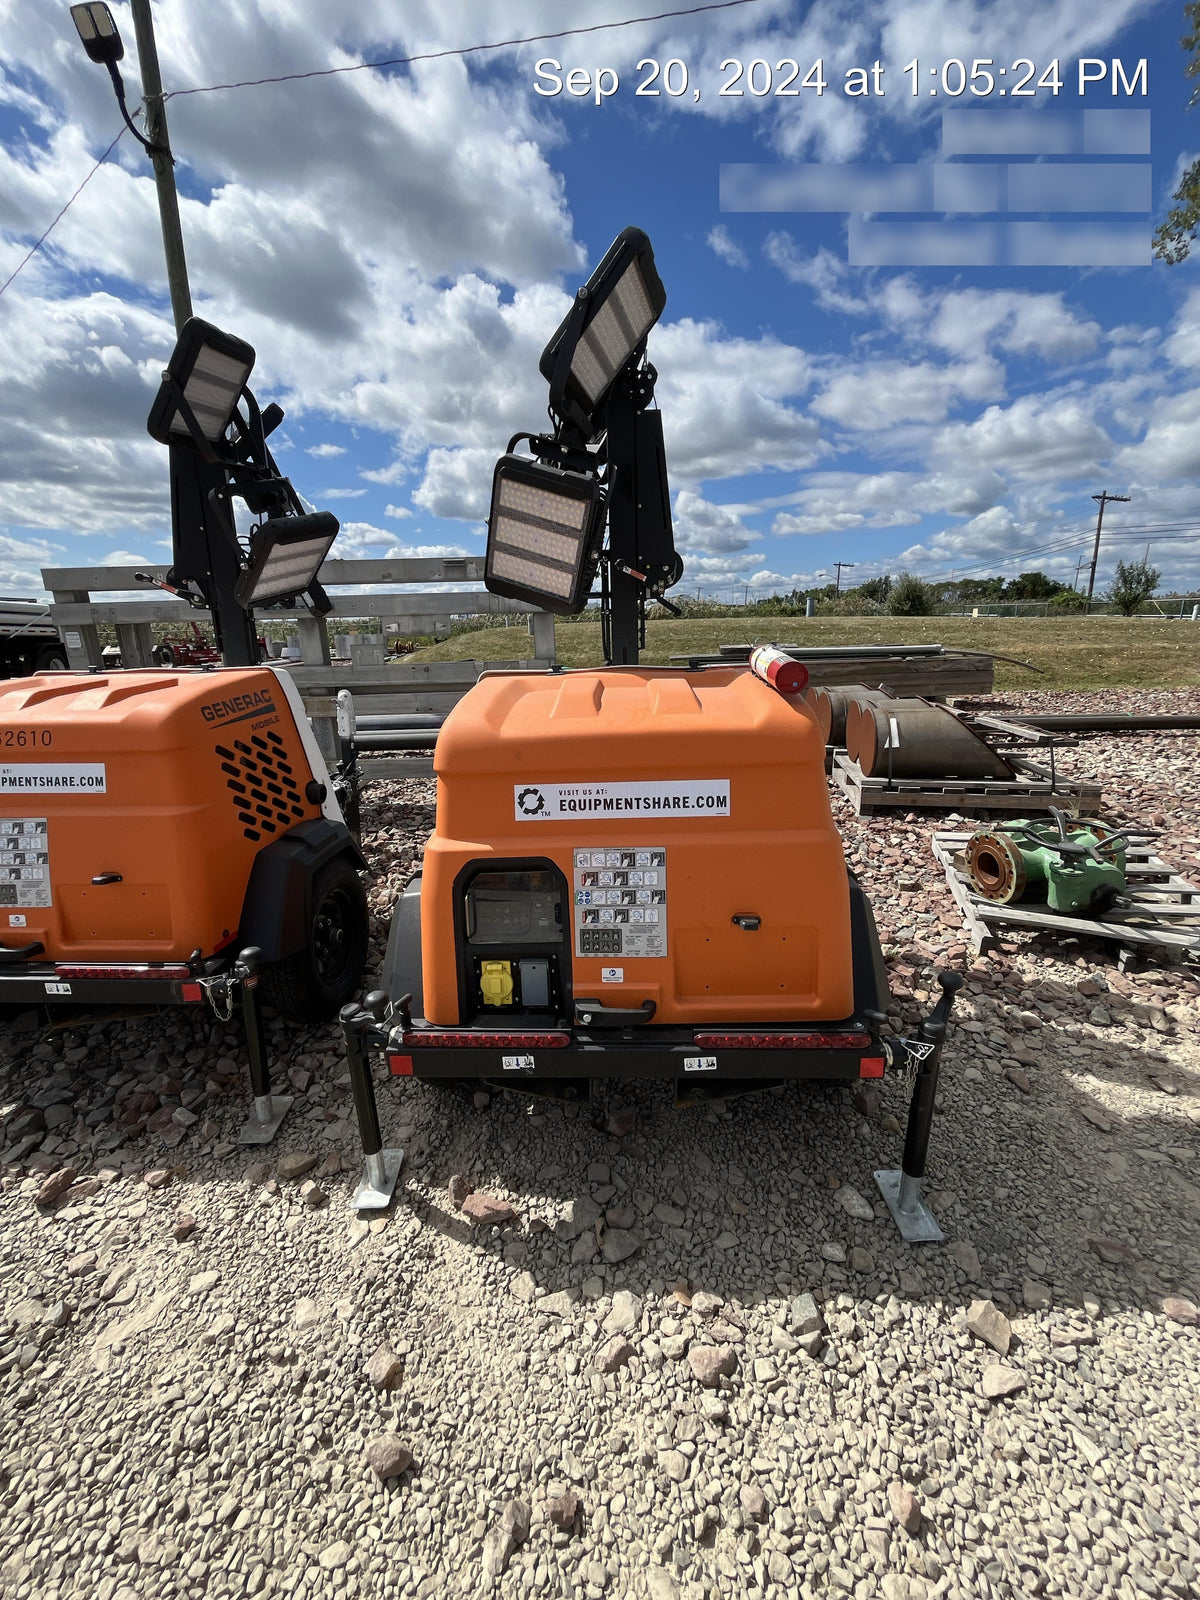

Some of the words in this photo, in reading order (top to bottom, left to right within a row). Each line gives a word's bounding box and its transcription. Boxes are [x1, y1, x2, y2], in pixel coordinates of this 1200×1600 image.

[200, 689, 273, 722] GENERAC
[251, 715, 280, 732] MOBILE
[0, 729, 52, 747] 2610
[1, 776, 104, 787] PMENTSHARE.COM
[559, 795, 727, 812] EQUIPMENTSHARE.COM
